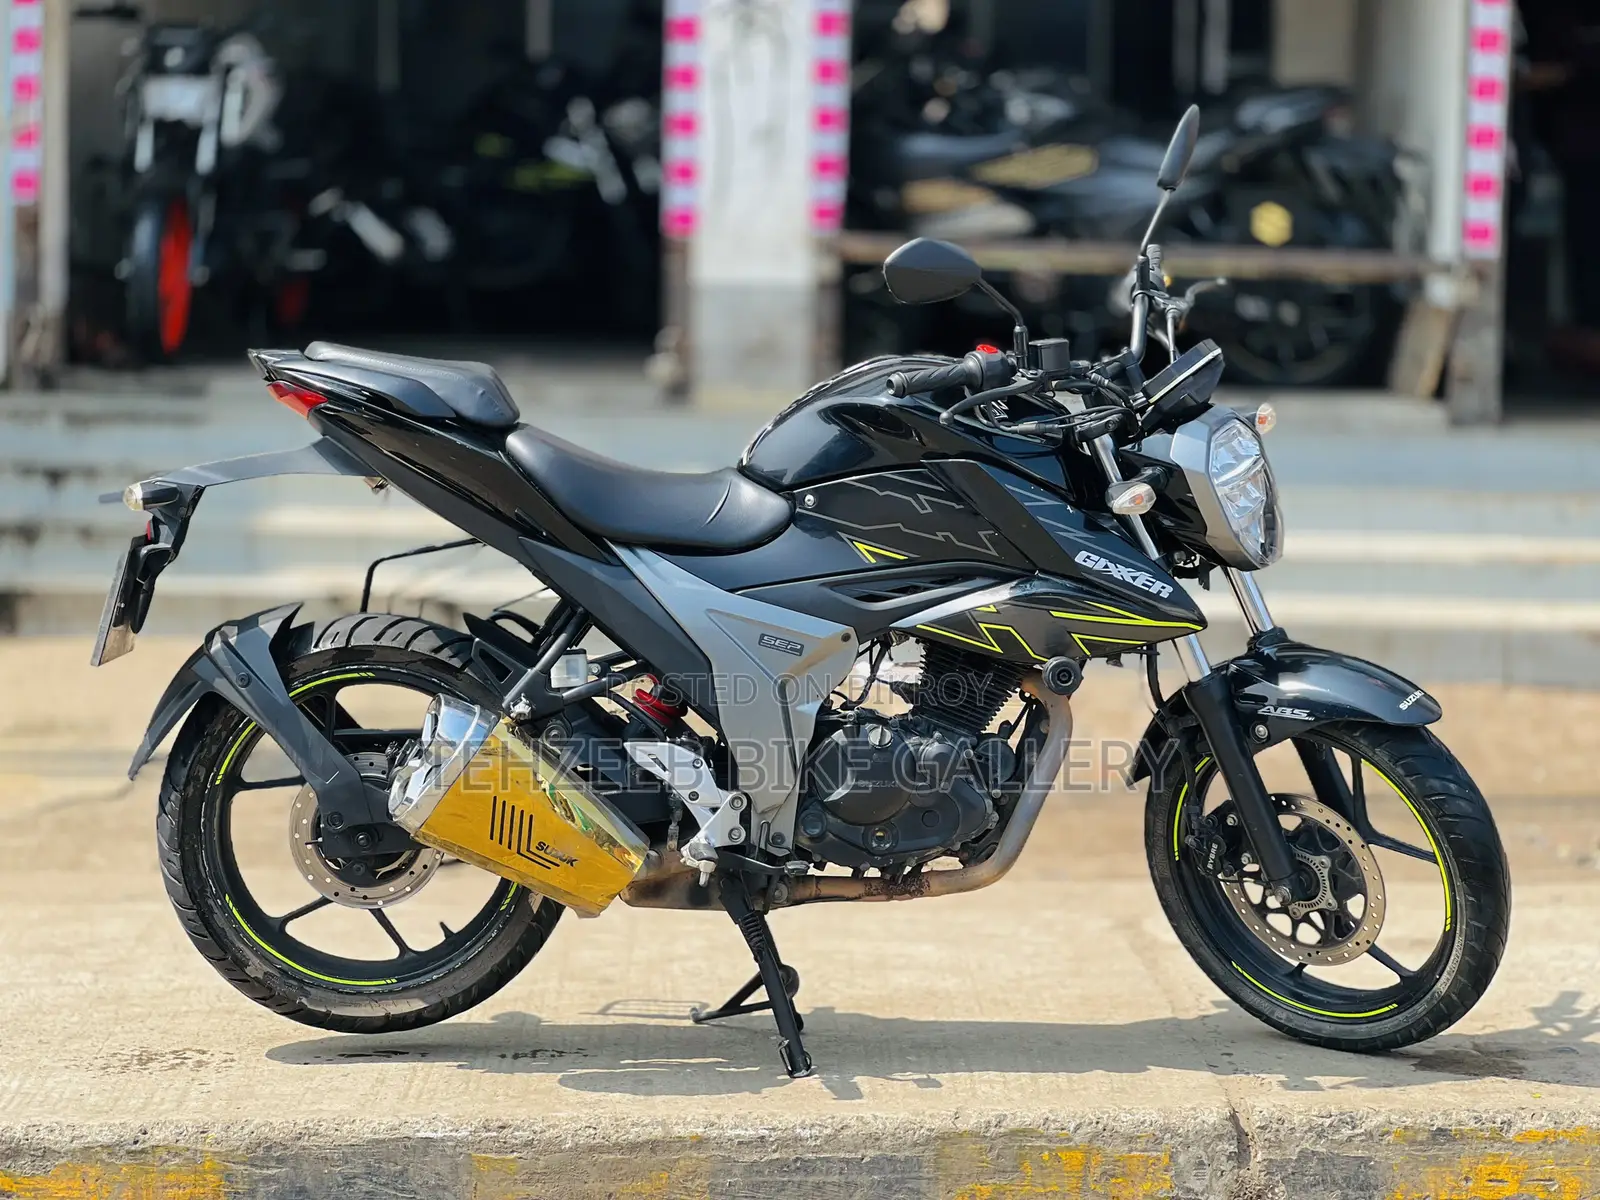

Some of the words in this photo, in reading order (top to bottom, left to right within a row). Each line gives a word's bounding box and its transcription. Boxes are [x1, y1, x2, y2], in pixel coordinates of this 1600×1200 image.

[1075, 550, 1174, 599] GIXXER
[762, 635, 801, 650] SEP
[1257, 705, 1311, 719] ABS
